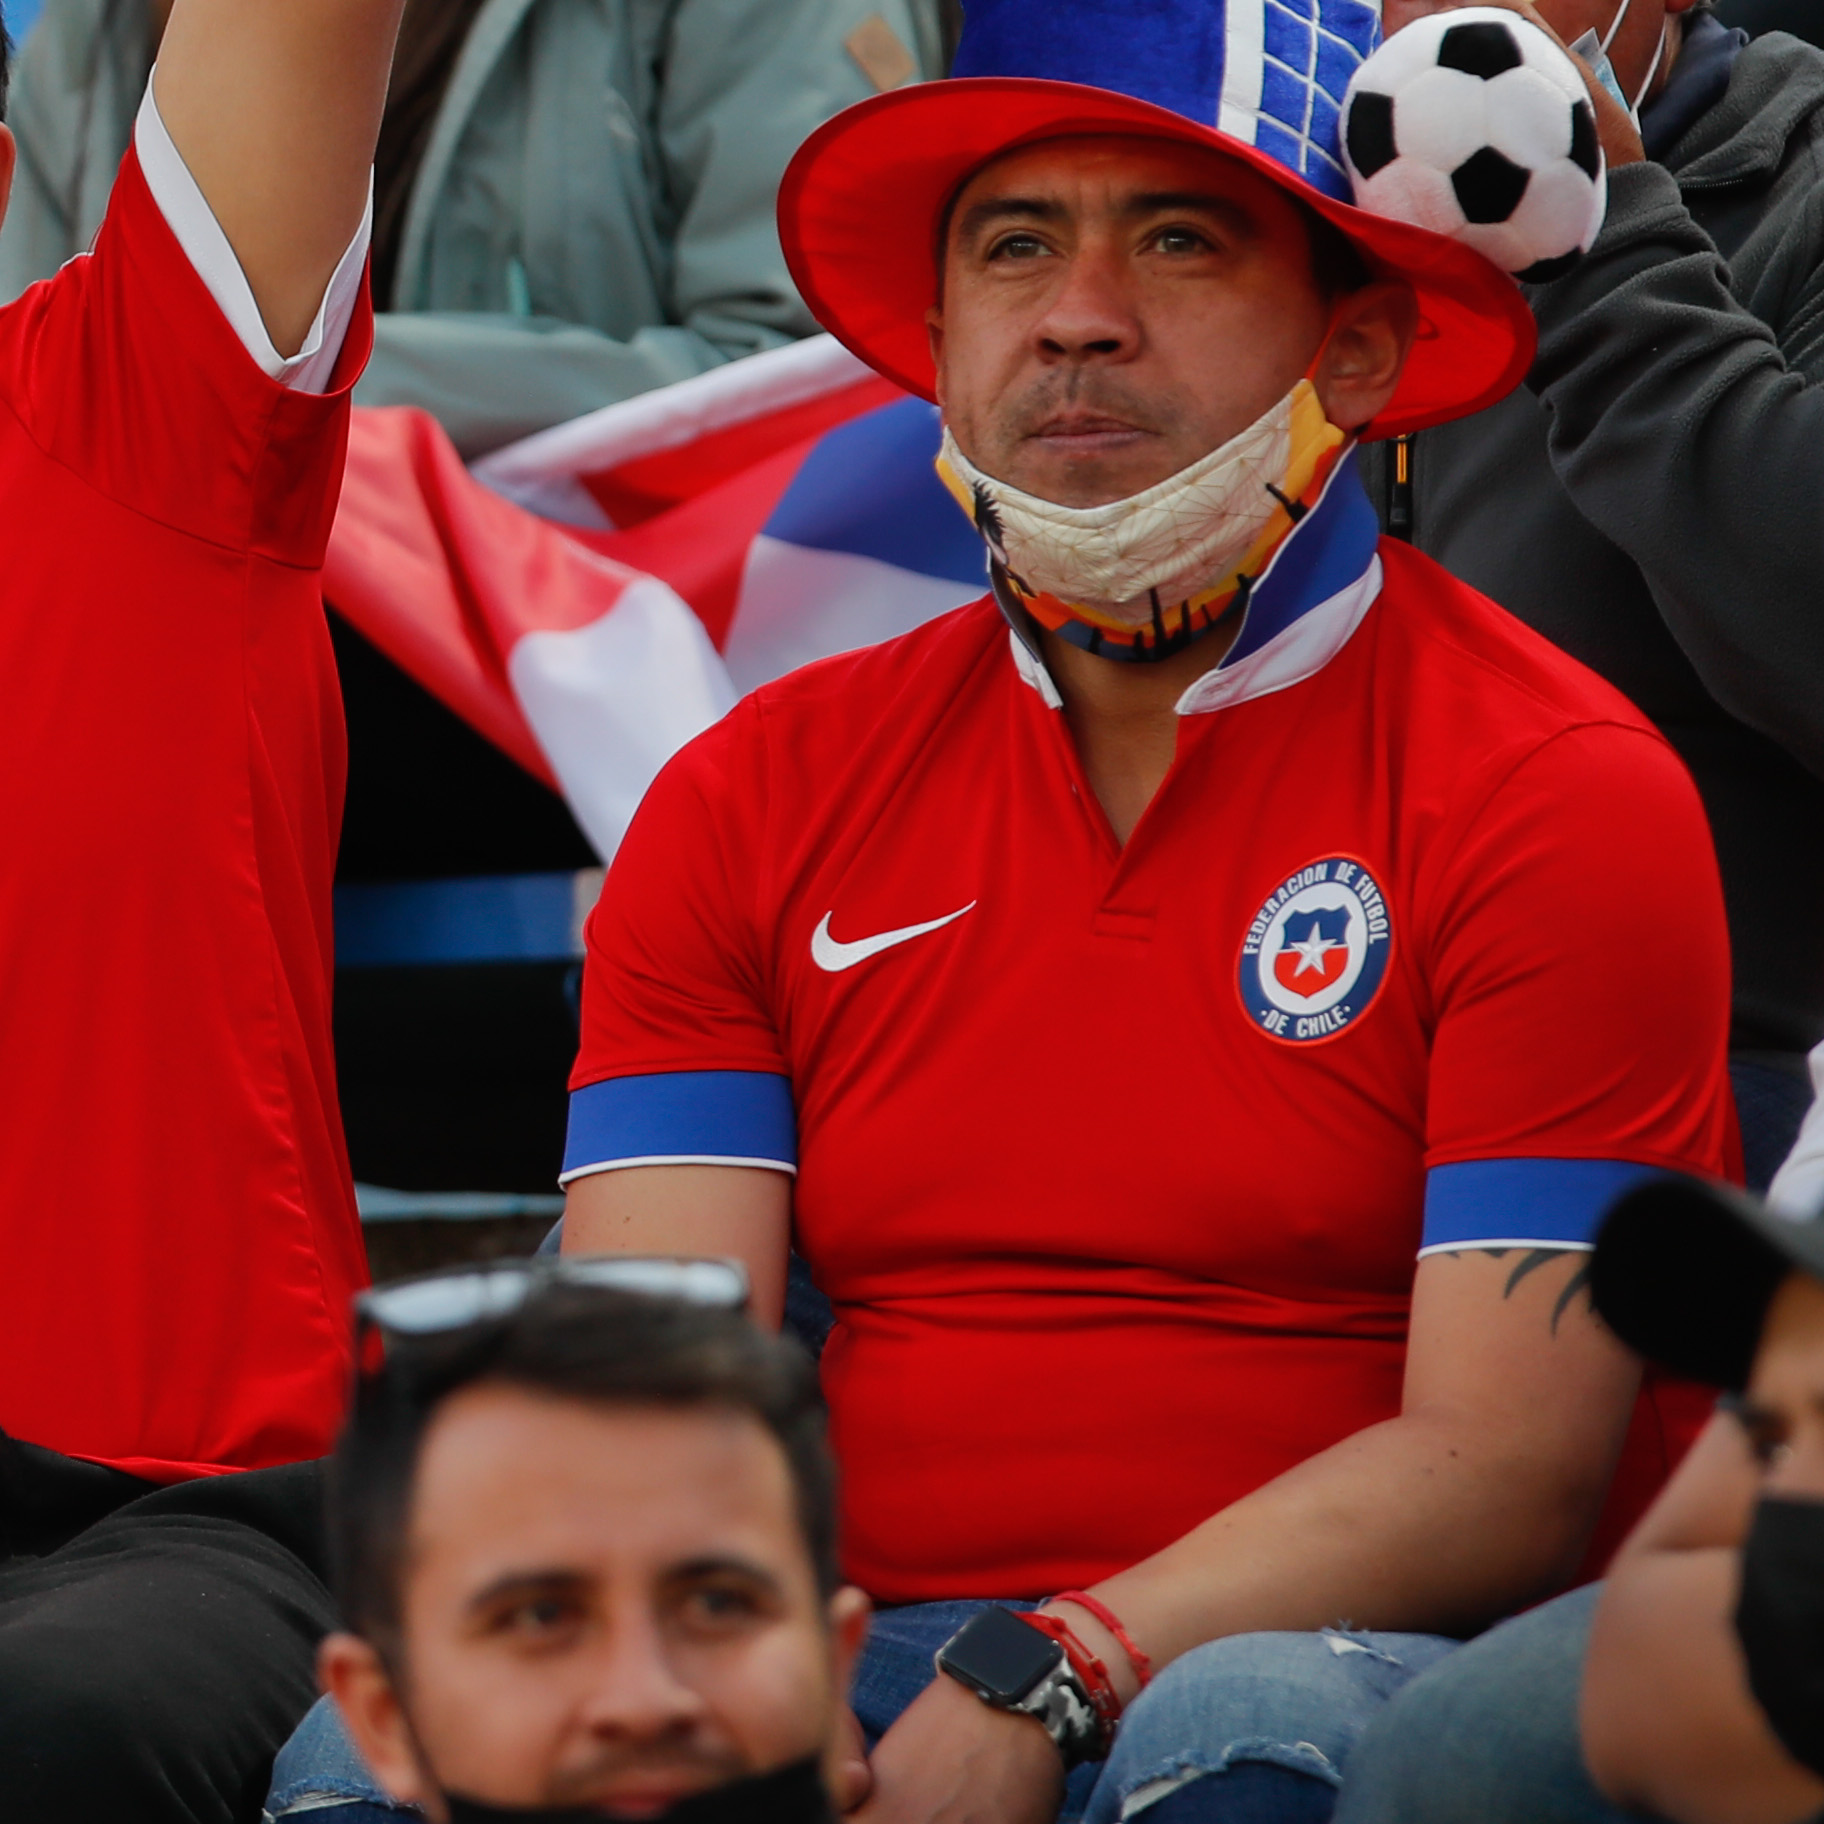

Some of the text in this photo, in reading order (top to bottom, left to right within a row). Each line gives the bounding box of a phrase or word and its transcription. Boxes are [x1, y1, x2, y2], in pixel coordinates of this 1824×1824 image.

[1243, 861, 1389, 955] FEDERACION DE FUTBOL
[1263, 1005, 1348, 1039] DE CHILE
